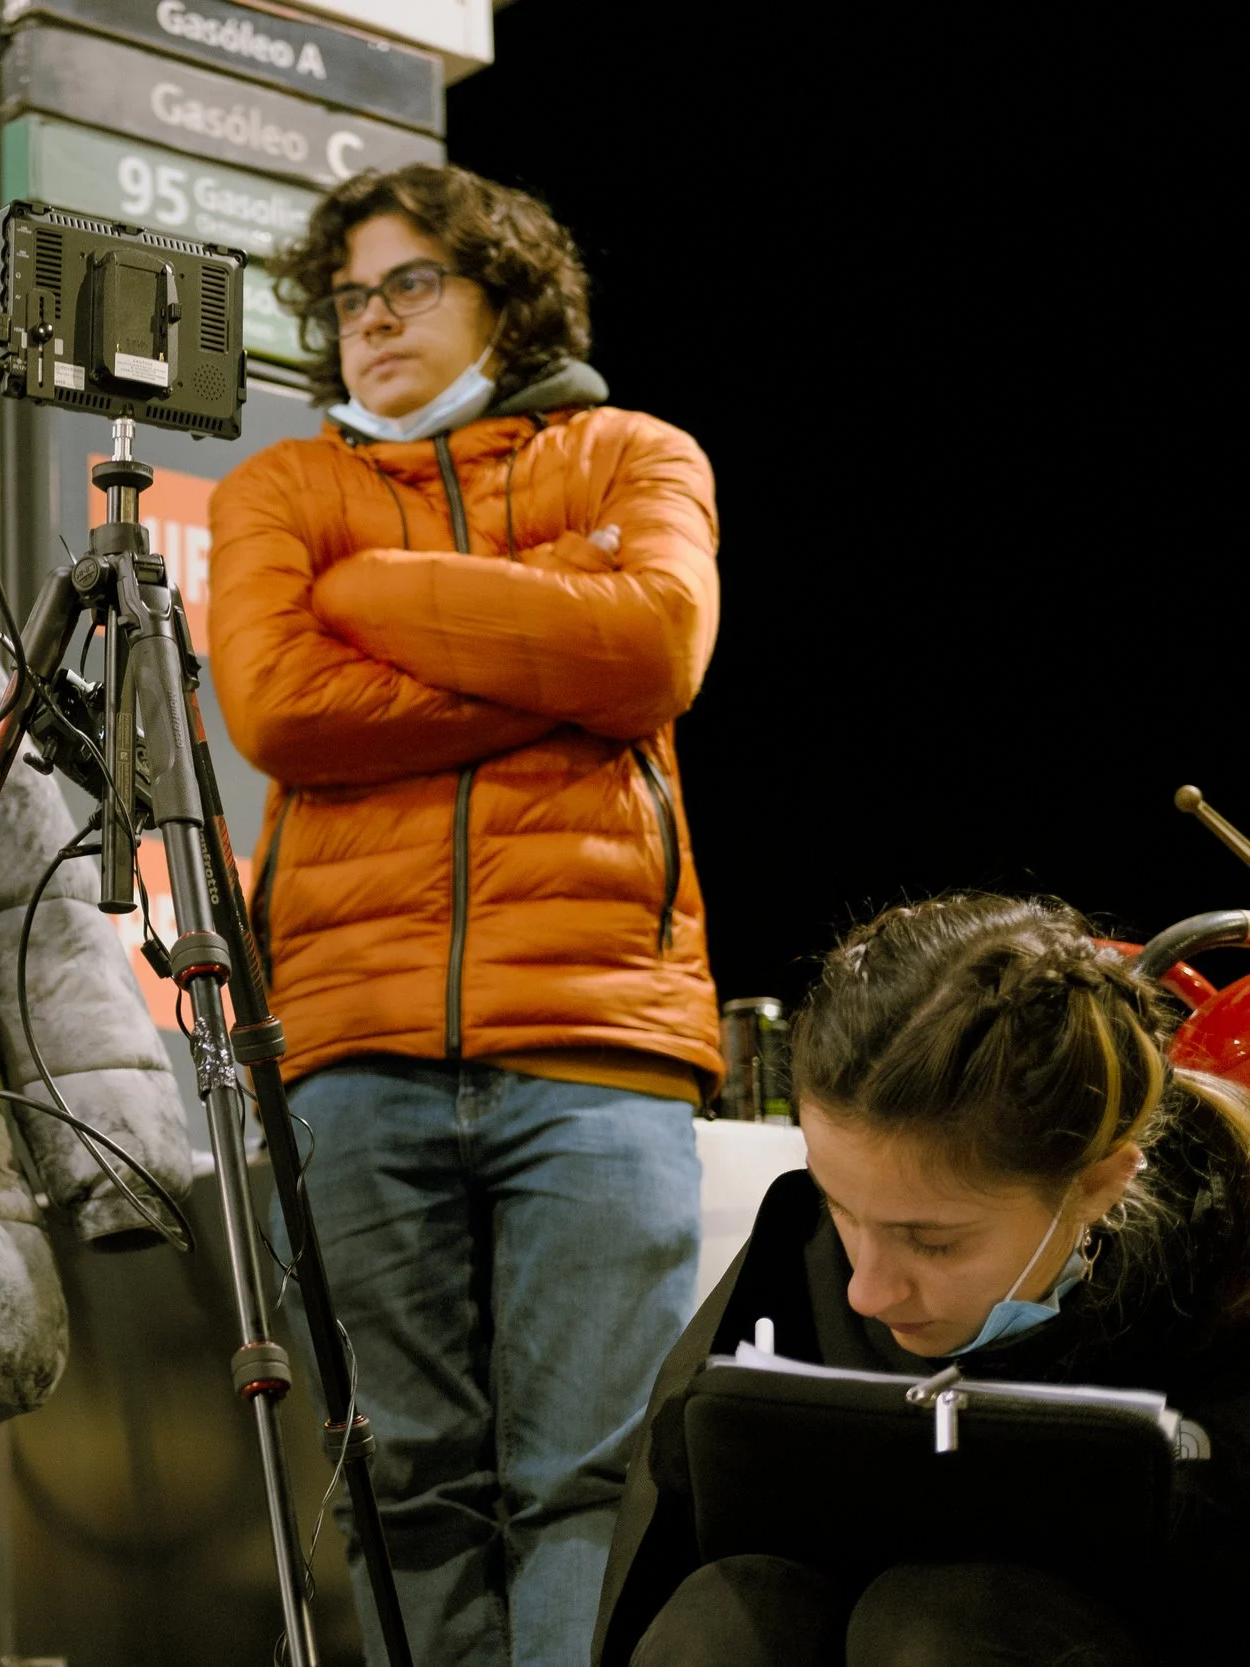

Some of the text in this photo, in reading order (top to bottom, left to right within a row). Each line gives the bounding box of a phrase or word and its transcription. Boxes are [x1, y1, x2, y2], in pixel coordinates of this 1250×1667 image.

[156, 0, 327, 80] Gasóleo A
[151, 82, 365, 180] Gasóleo C
[118, 156, 190, 226] 95
